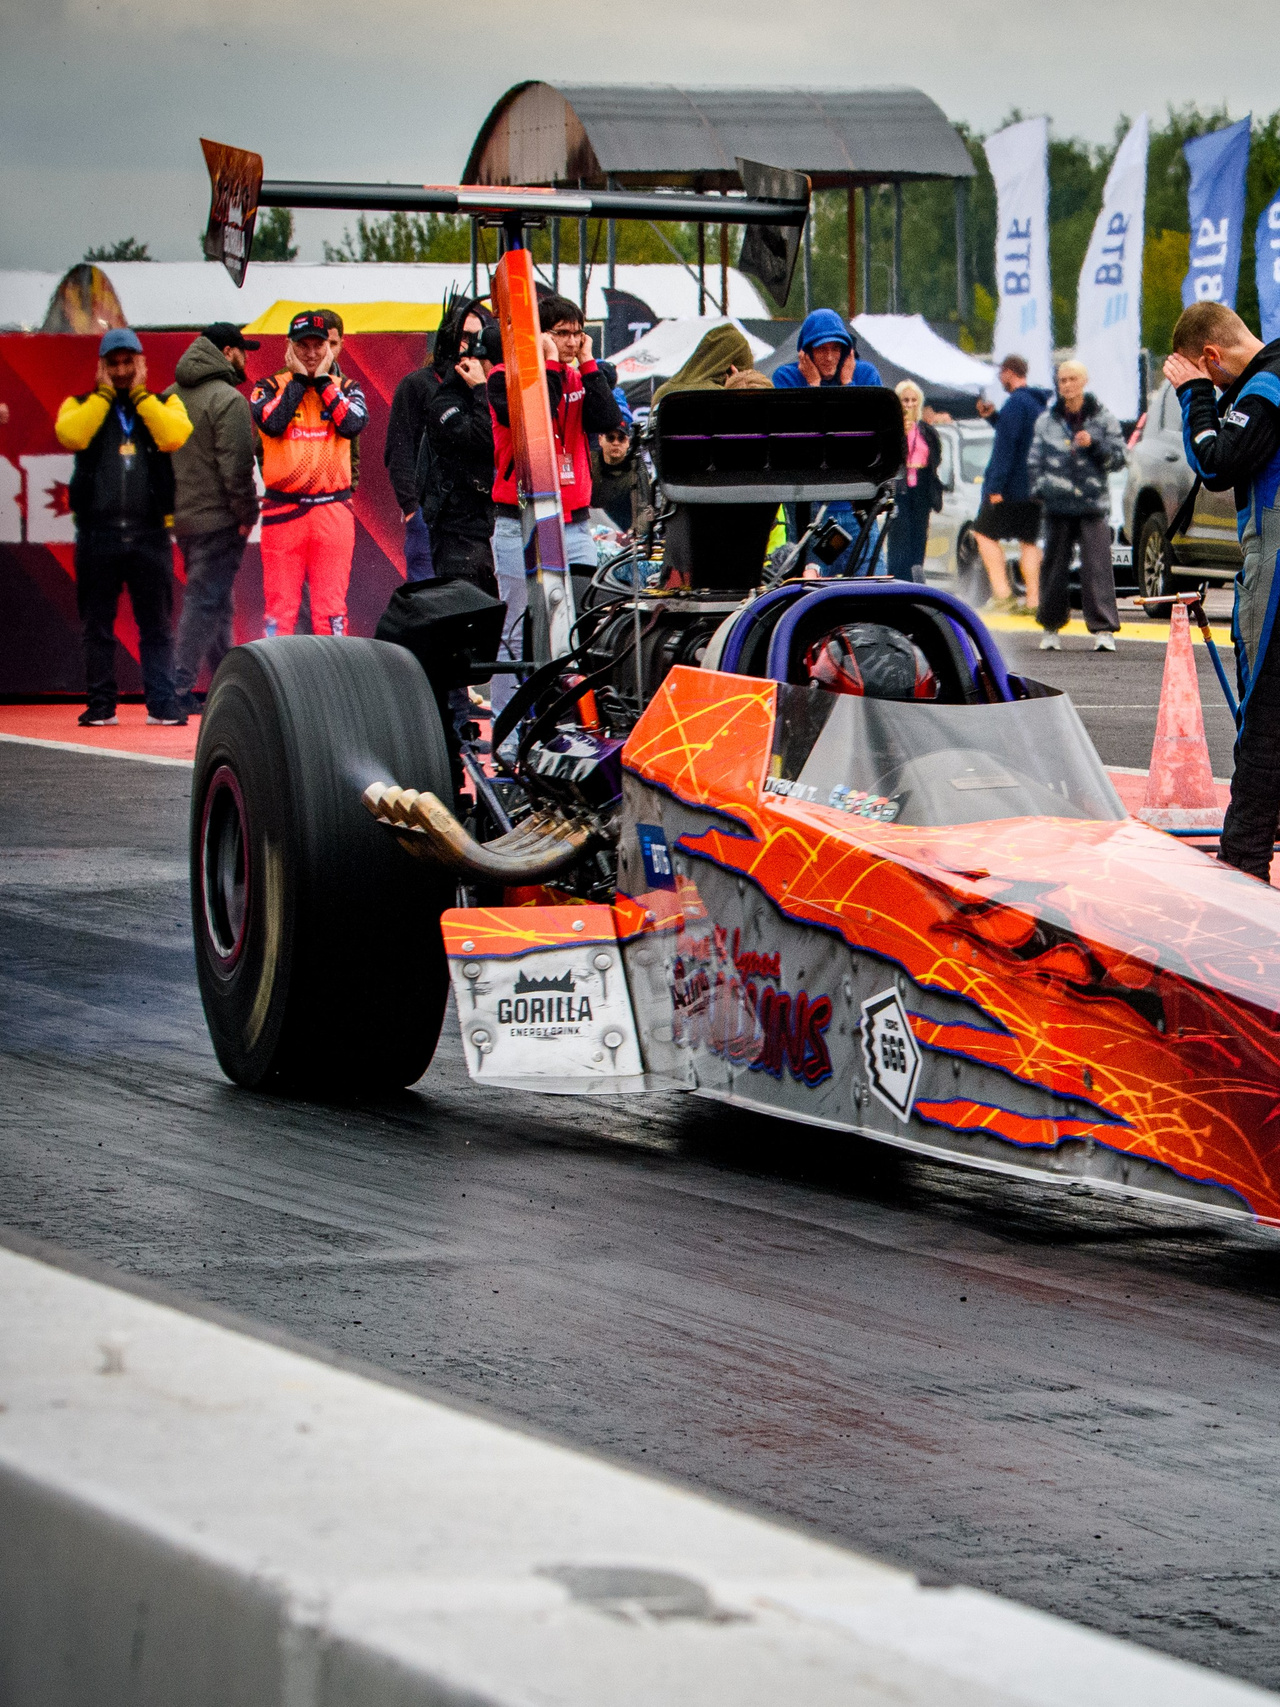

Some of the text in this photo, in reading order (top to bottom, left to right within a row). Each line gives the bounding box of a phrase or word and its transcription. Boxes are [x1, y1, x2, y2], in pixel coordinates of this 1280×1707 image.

[498, 996, 593, 1024] GORILLA
[510, 1026, 581, 1037] ENERGY DRINK
